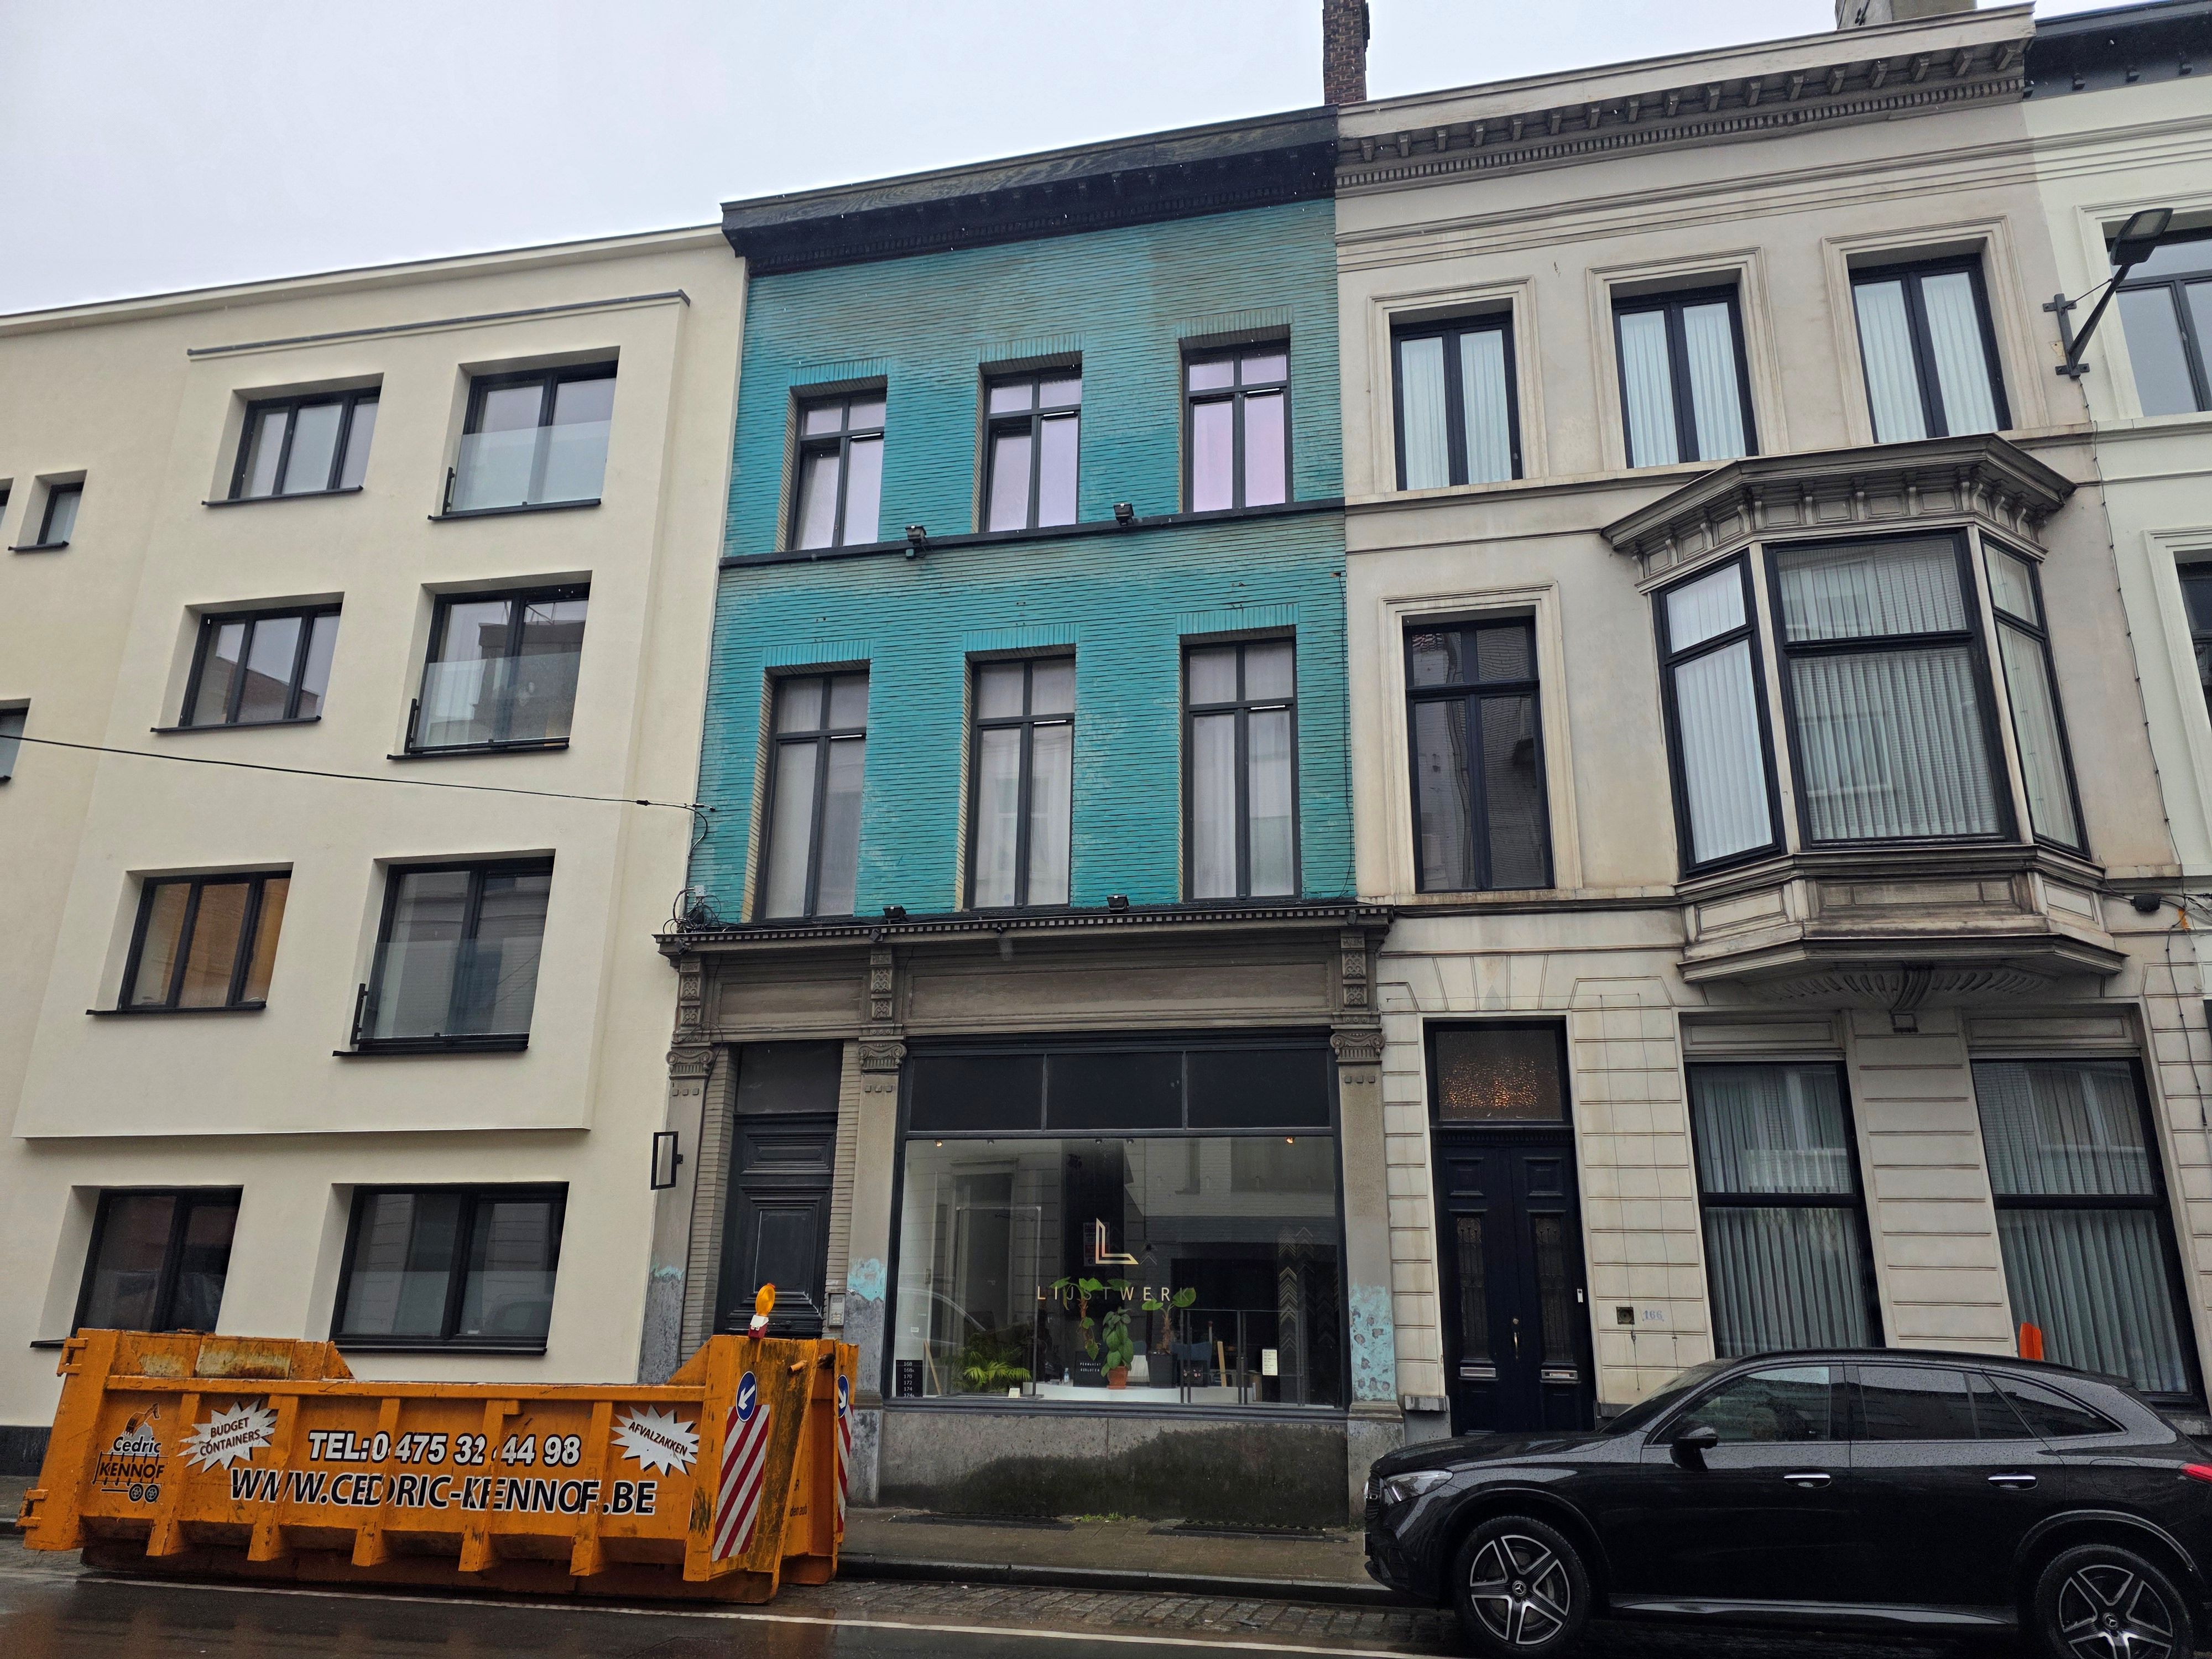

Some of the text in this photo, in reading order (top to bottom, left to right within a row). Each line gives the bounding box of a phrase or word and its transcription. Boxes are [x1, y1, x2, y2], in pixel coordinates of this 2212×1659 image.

[1037, 1286, 1190, 1301] LIJSTWERK
[1643, 1310, 1663, 1319] 166
[211, 1417, 249, 1438] BUDGET
[113, 1436, 161, 1453] Cedric
[200, 1429, 260, 1457] CONTAINERS
[628, 1421, 688, 1457] AFVALZAKKEN
[394, 1433, 448, 1464] 475
[453, 1433, 486, 1465] 32
[492, 1434, 536, 1466] 44
[543, 1434, 581, 1467] 98
[99, 1462, 165, 1479] KENNOF
